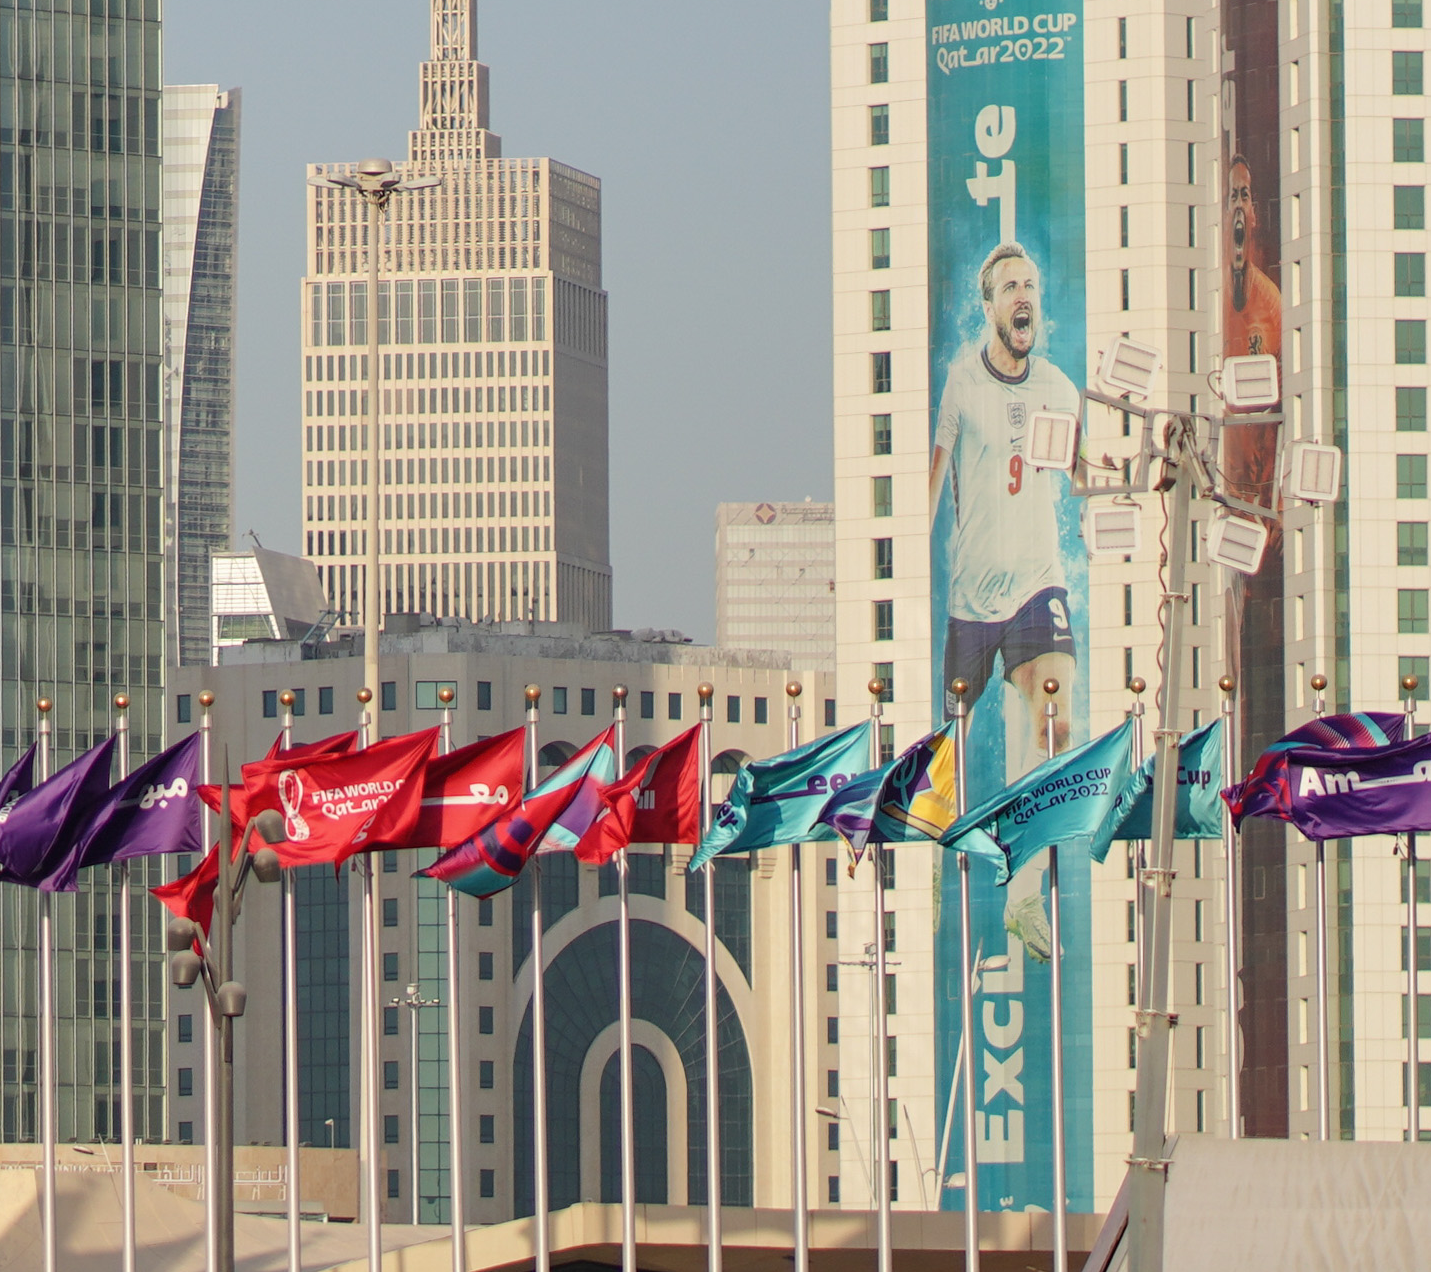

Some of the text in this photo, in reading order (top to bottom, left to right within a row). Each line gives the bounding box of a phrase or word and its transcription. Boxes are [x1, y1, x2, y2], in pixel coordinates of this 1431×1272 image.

[931, 13, 1077, 45] FIFA WORLD CUP
[1007, 454, 1023, 496] 9
[311, 789, 344, 805] FIFA
[344, 780, 392, 802] WORLD
[1004, 767, 1111, 820] FIFA WORLD CUP
